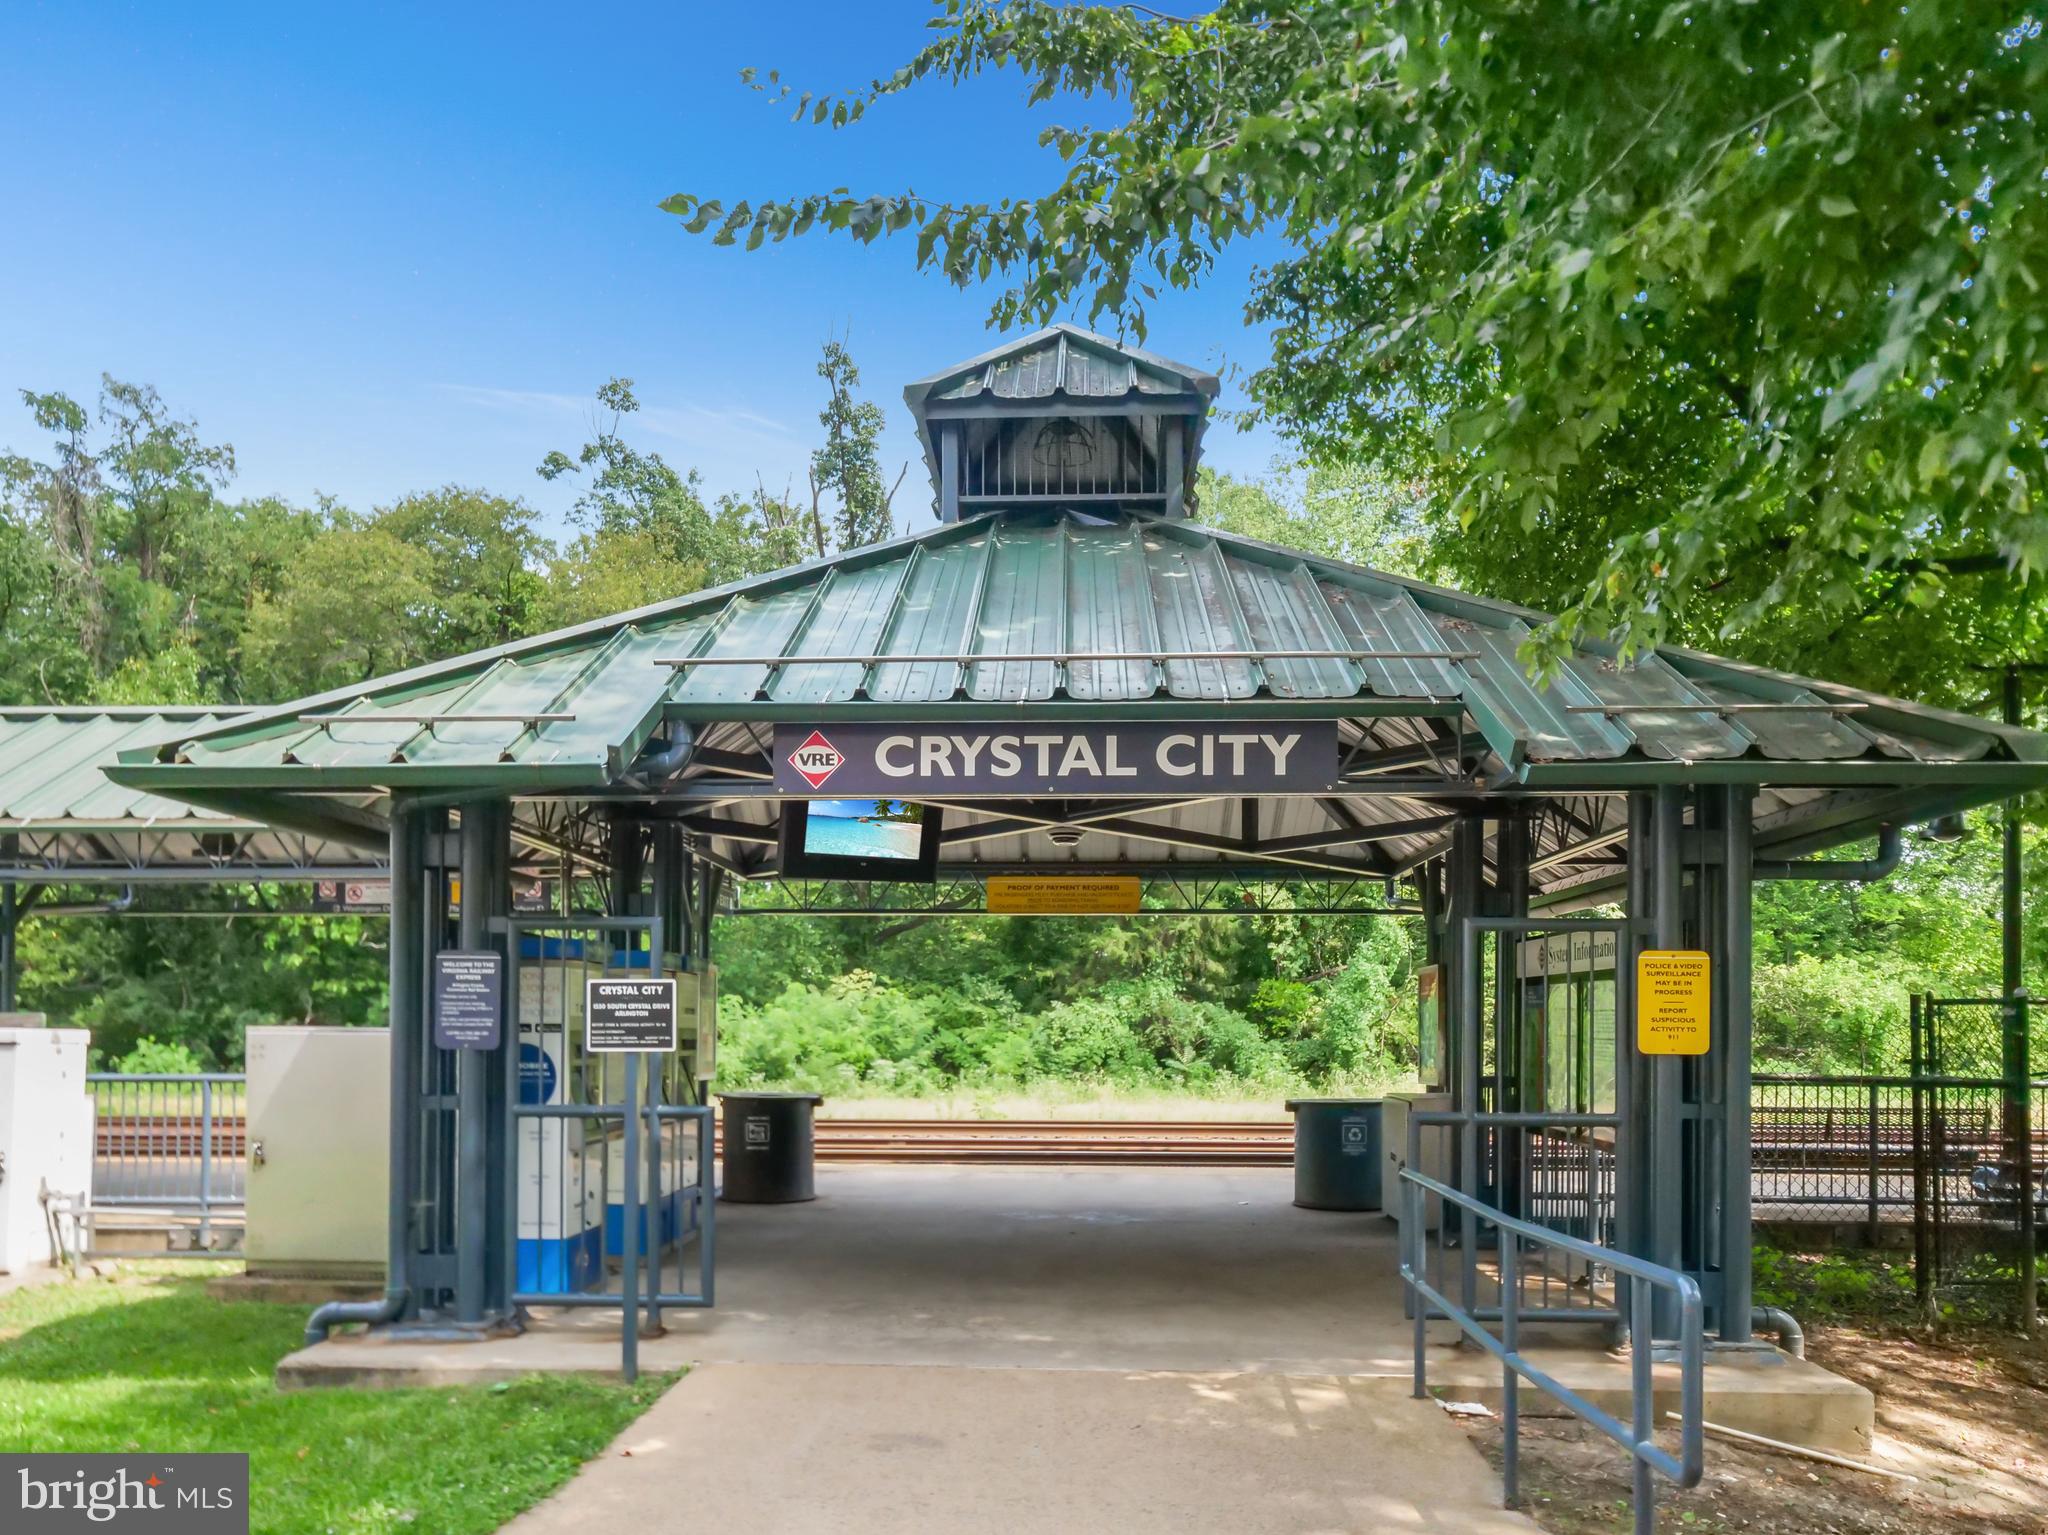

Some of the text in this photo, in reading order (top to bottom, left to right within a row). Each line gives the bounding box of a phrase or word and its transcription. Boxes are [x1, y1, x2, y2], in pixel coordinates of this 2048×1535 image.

[798, 752, 836, 767] VRE
[875, 734, 1302, 778] CRYSTAL CITY
[1548, 945, 1569, 969] Syste
[599, 985, 664, 995] CRYSTAL CITY
